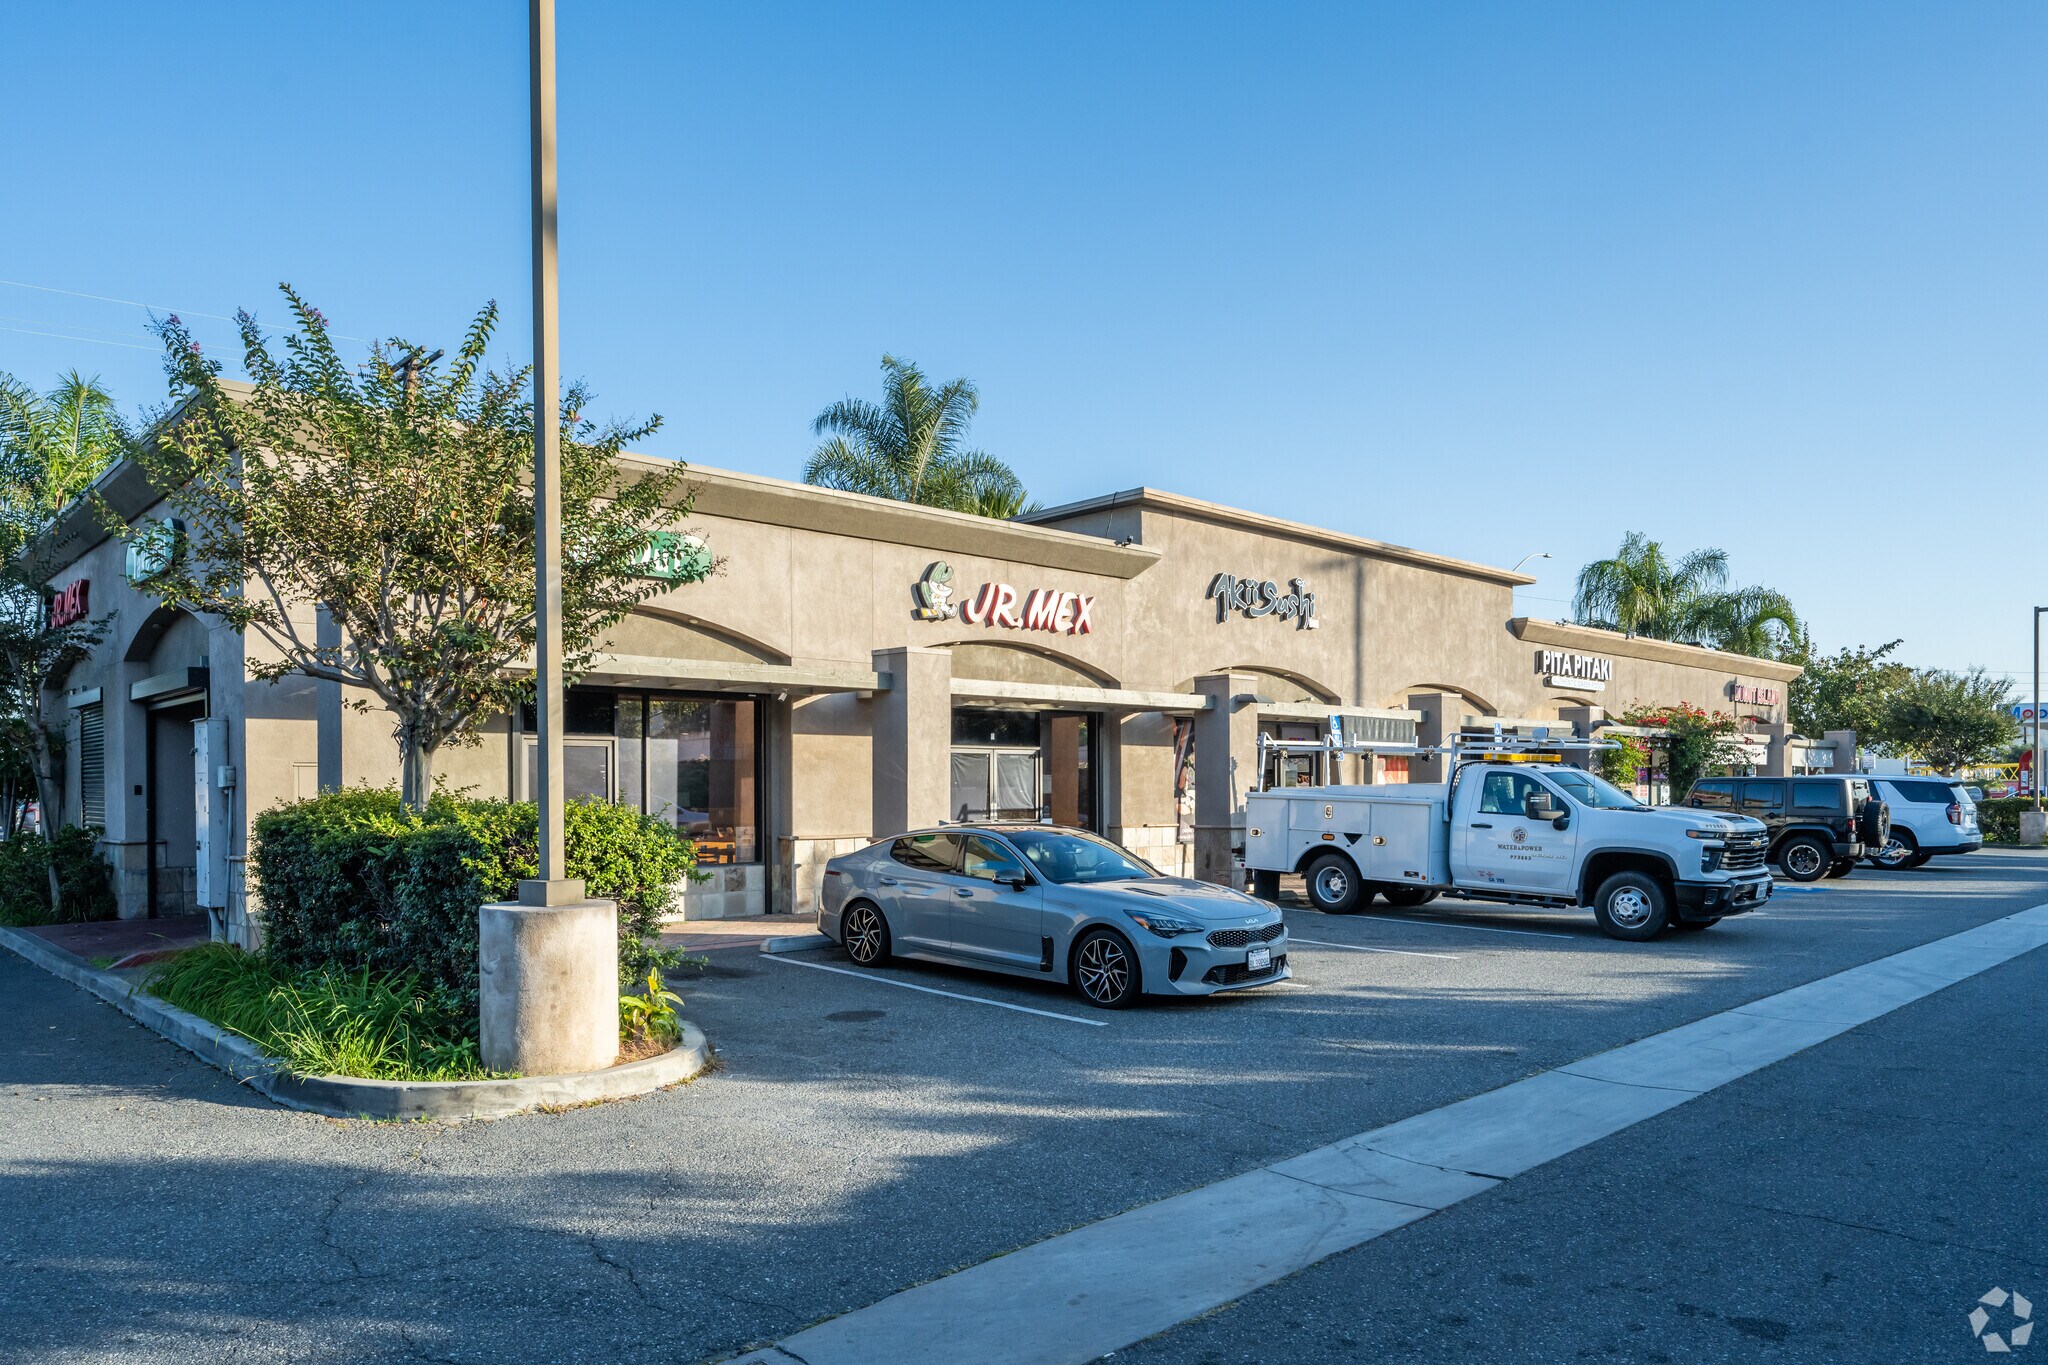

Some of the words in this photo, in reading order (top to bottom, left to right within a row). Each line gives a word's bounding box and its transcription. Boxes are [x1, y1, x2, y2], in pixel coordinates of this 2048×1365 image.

[1250, 578, 1316, 630] Sushi
[1543, 650, 1572, 676] PITA
[1574, 655, 1613, 681] PITAKI
